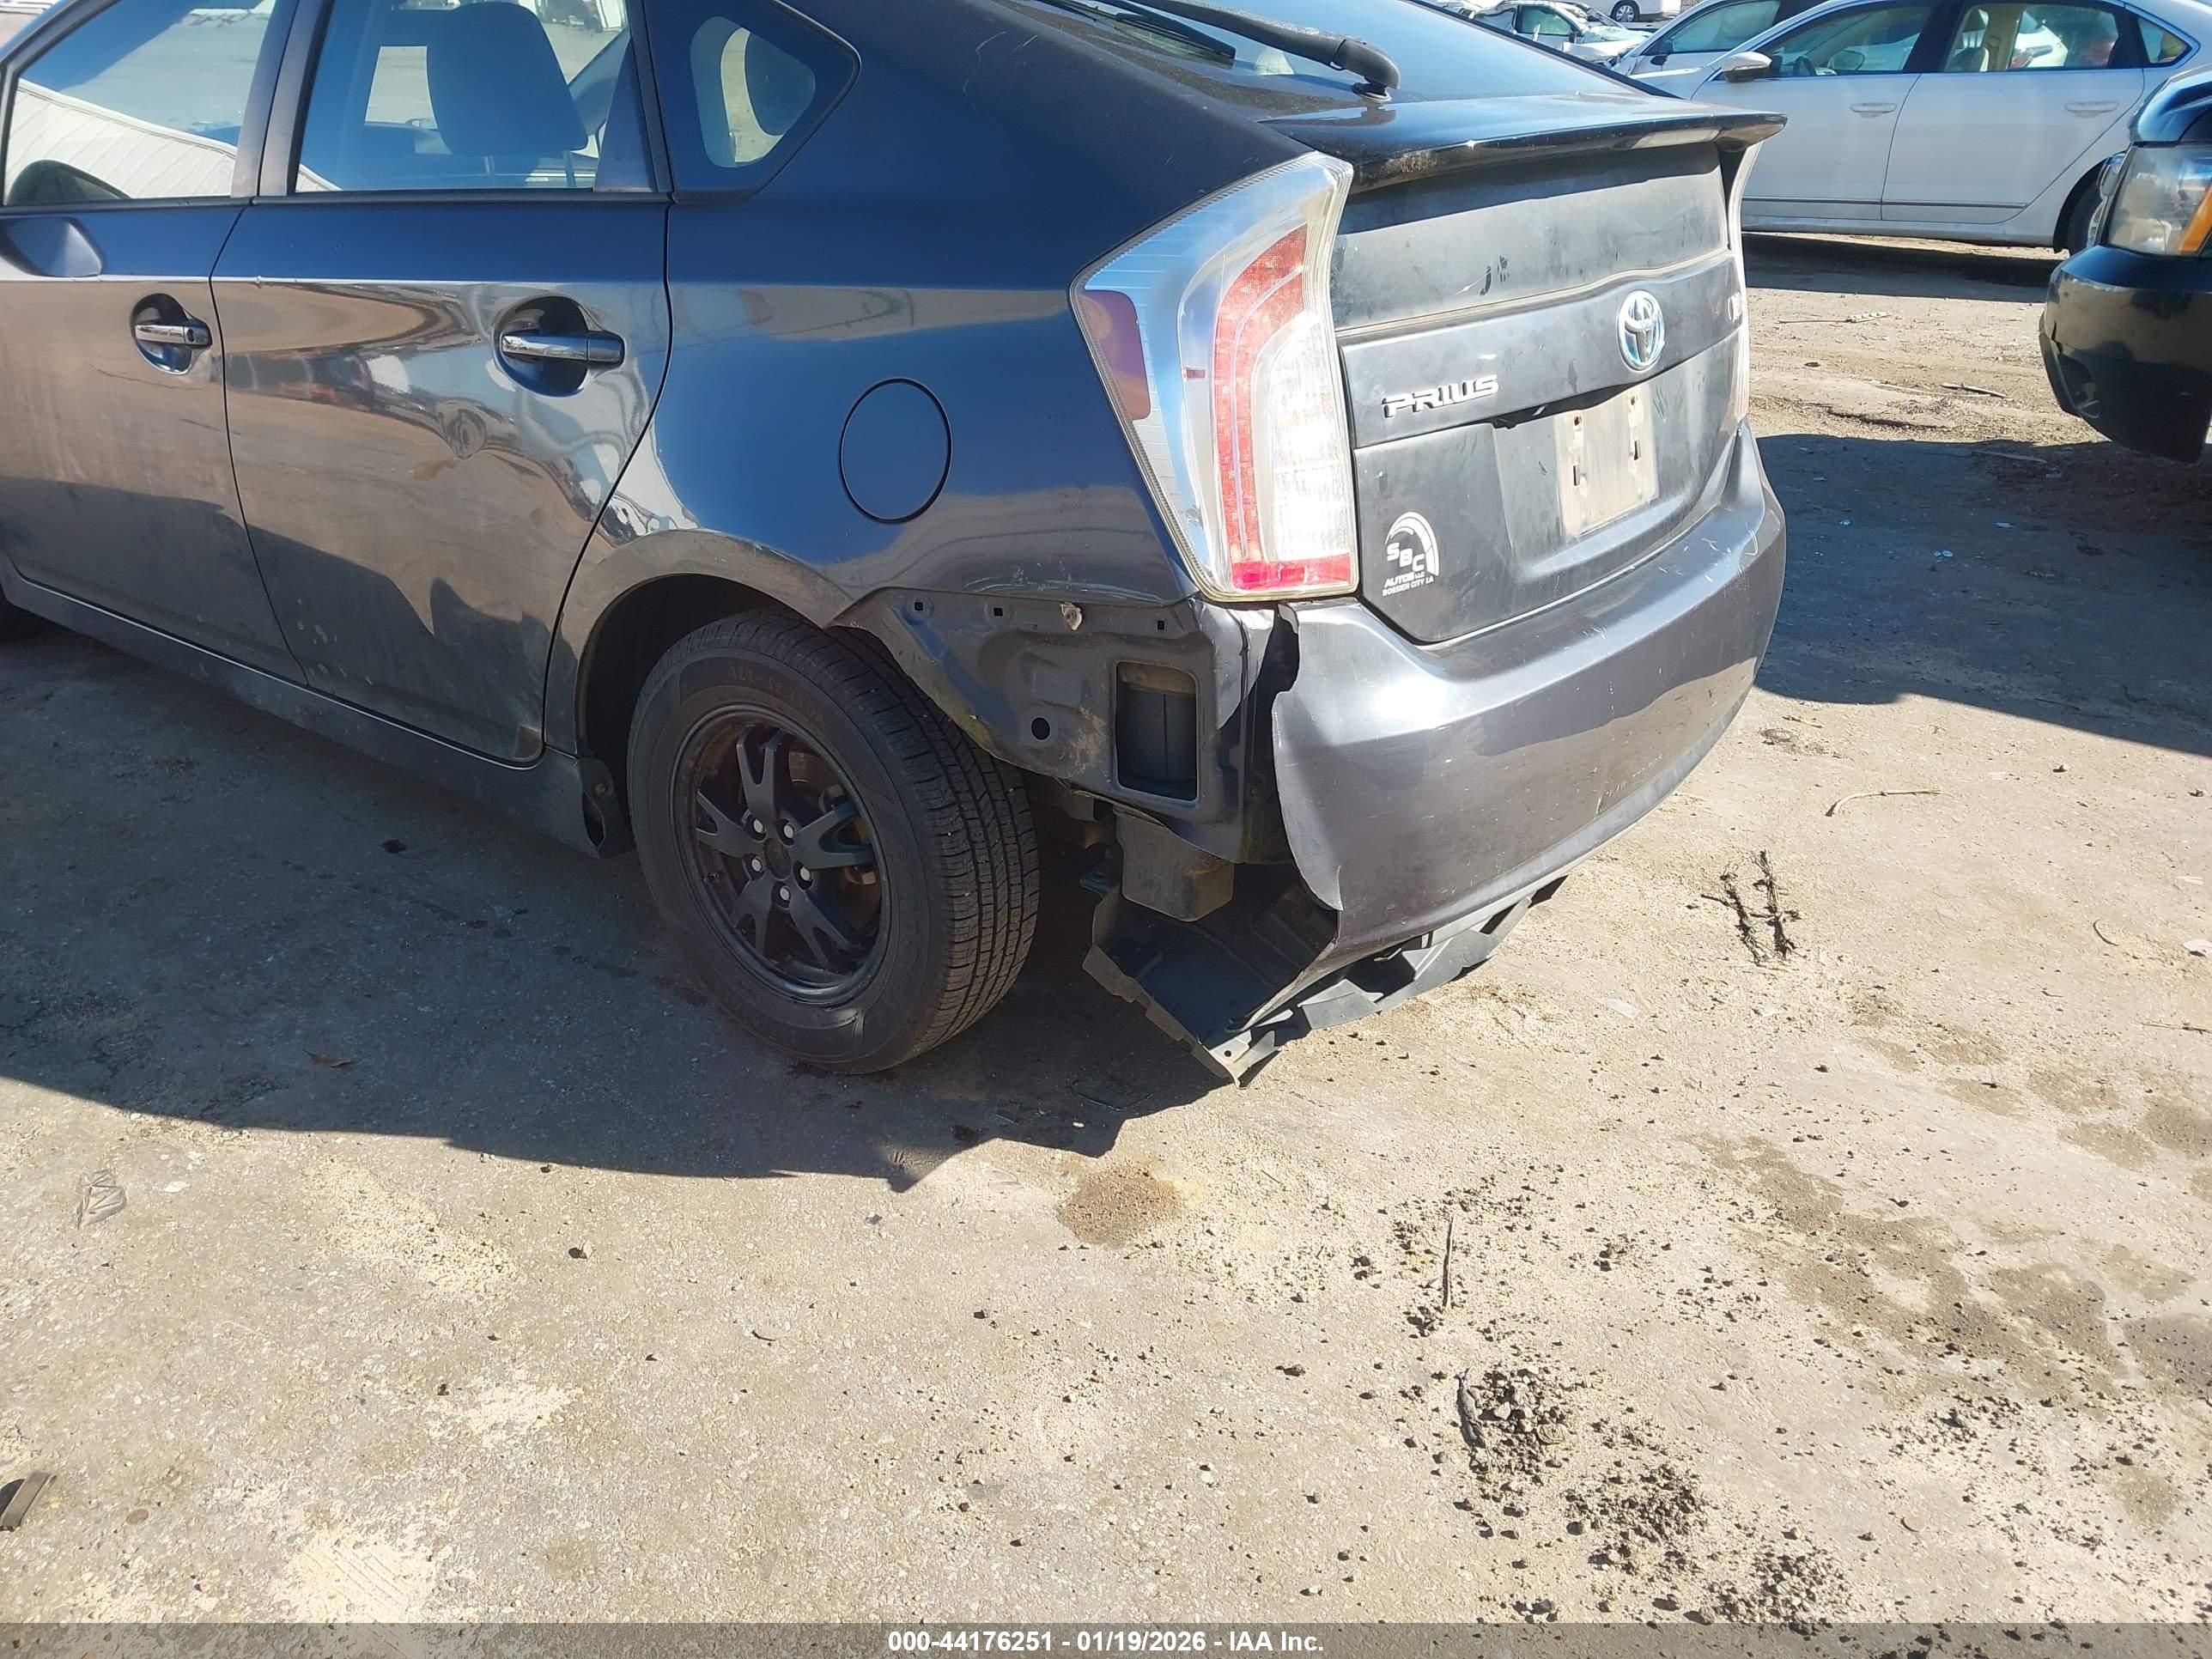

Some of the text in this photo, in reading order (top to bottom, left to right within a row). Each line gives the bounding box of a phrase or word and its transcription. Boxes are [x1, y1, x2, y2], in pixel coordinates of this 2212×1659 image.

[1382, 374, 1499, 418] PRIUS
[1387, 542, 1425, 572] SBC
[1382, 575, 1434, 597] BOSSIER CITY LA
[1383, 571, 1425, 588] AUTOS LLC
